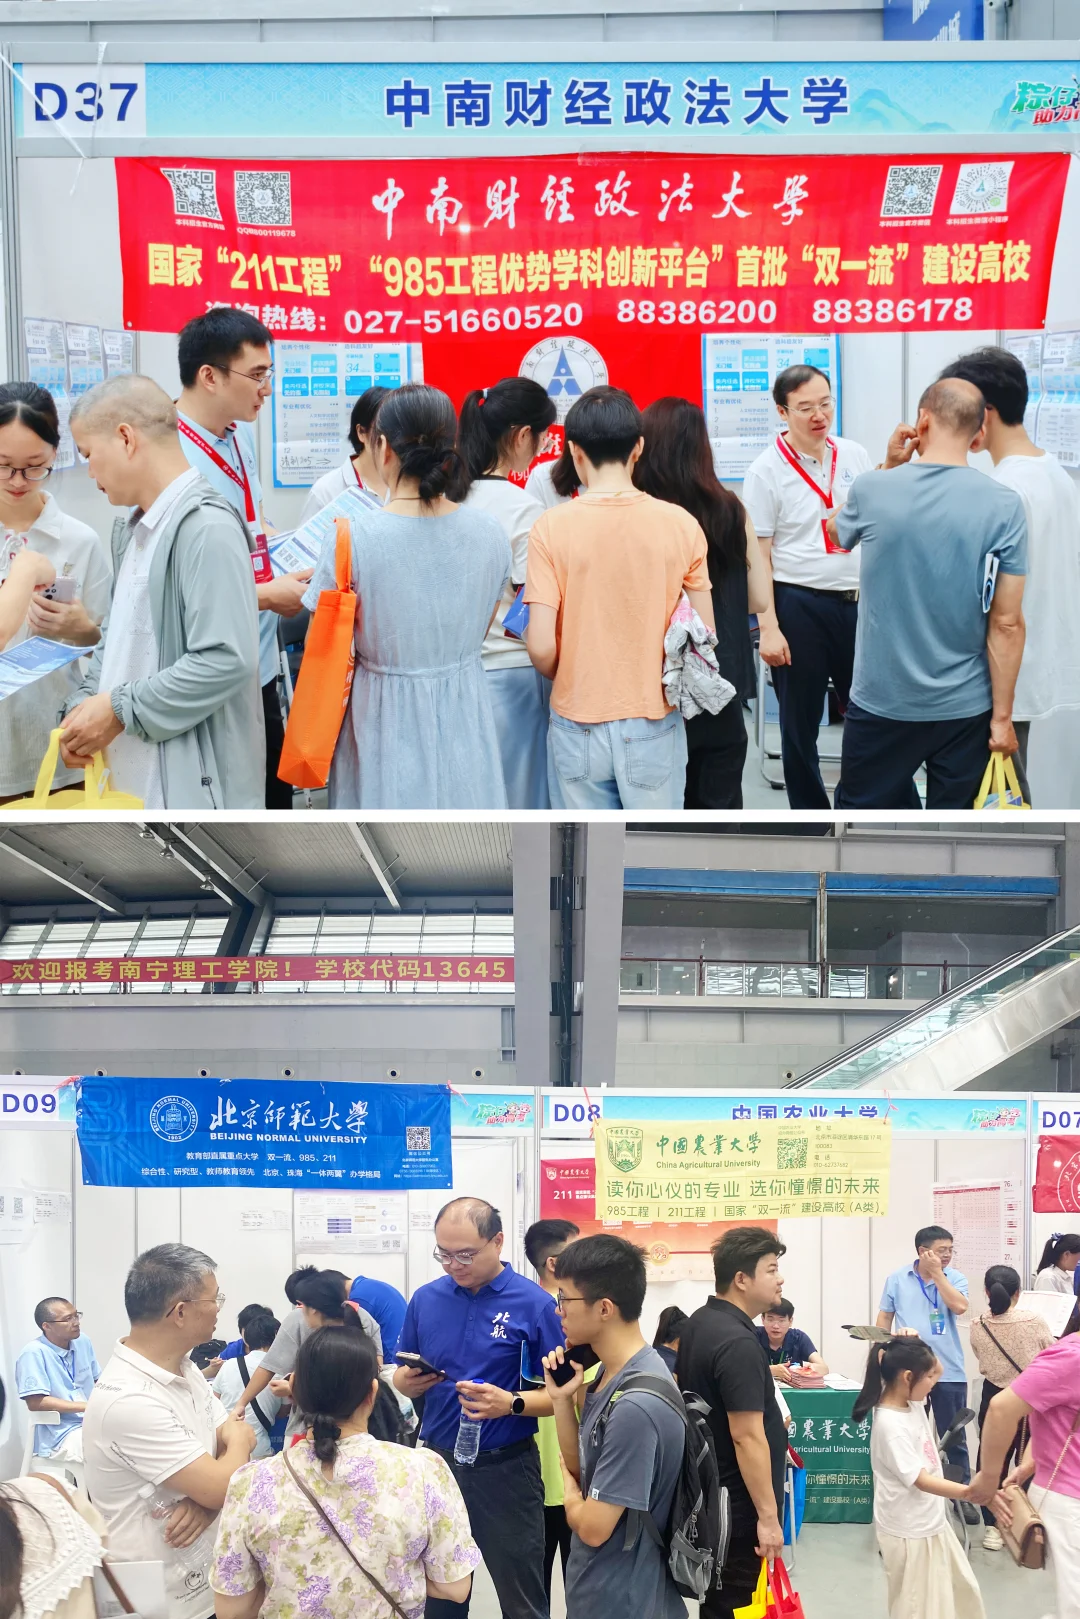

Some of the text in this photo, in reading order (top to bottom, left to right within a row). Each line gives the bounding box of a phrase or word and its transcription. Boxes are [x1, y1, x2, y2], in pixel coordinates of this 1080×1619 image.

[34, 82, 139, 122] D37
[385, 77, 849, 129] 中南财经政法大学
[1012, 81, 1077, 112] 粽仔
[148, 243, 203, 288] 国家
[736, 245, 788, 287] 首批
[921, 239, 1031, 285] 建设高校
[344, 303, 584, 335] 027-51660520
[617, 299, 777, 325] 88386200
[812, 298, 974, 324] 88386178
[12, 959, 506, 980] 欢迎报考南宁理工学院！ 学校代码13645
[2, 1093, 57, 1113] D09
[554, 1104, 600, 1122] D08
[1042, 1111, 1080, 1128] D07
[210, 1132, 368, 1144] BEIJING NORMAL UNIVERSITY
[186, 1152, 259, 1161] 教育部直属重点大学
[656, 1160, 761, 1170] China Agricultural University
[141, 1167, 255, 1176] 综合性、研究型、教师教育领先
[263, 1168, 303, 1177] 北京、珠海
[350, 1170, 380, 1179] 办学格局
[553, 1190, 572, 1199] 211
[607, 1180, 740, 1199] 读你心仪的专业
[750, 1177, 880, 1197] 选你憧憬的未来
[607, 1205, 649, 1217] 985工程
[668, 1206, 706, 1217] 211工程
[724, 1205, 747, 1217] 国家
[490, 1311, 510, 1339] 北航
[833, 1445, 871, 1455] University
[805, 1473, 871, 1486] 你憧憬的未来
